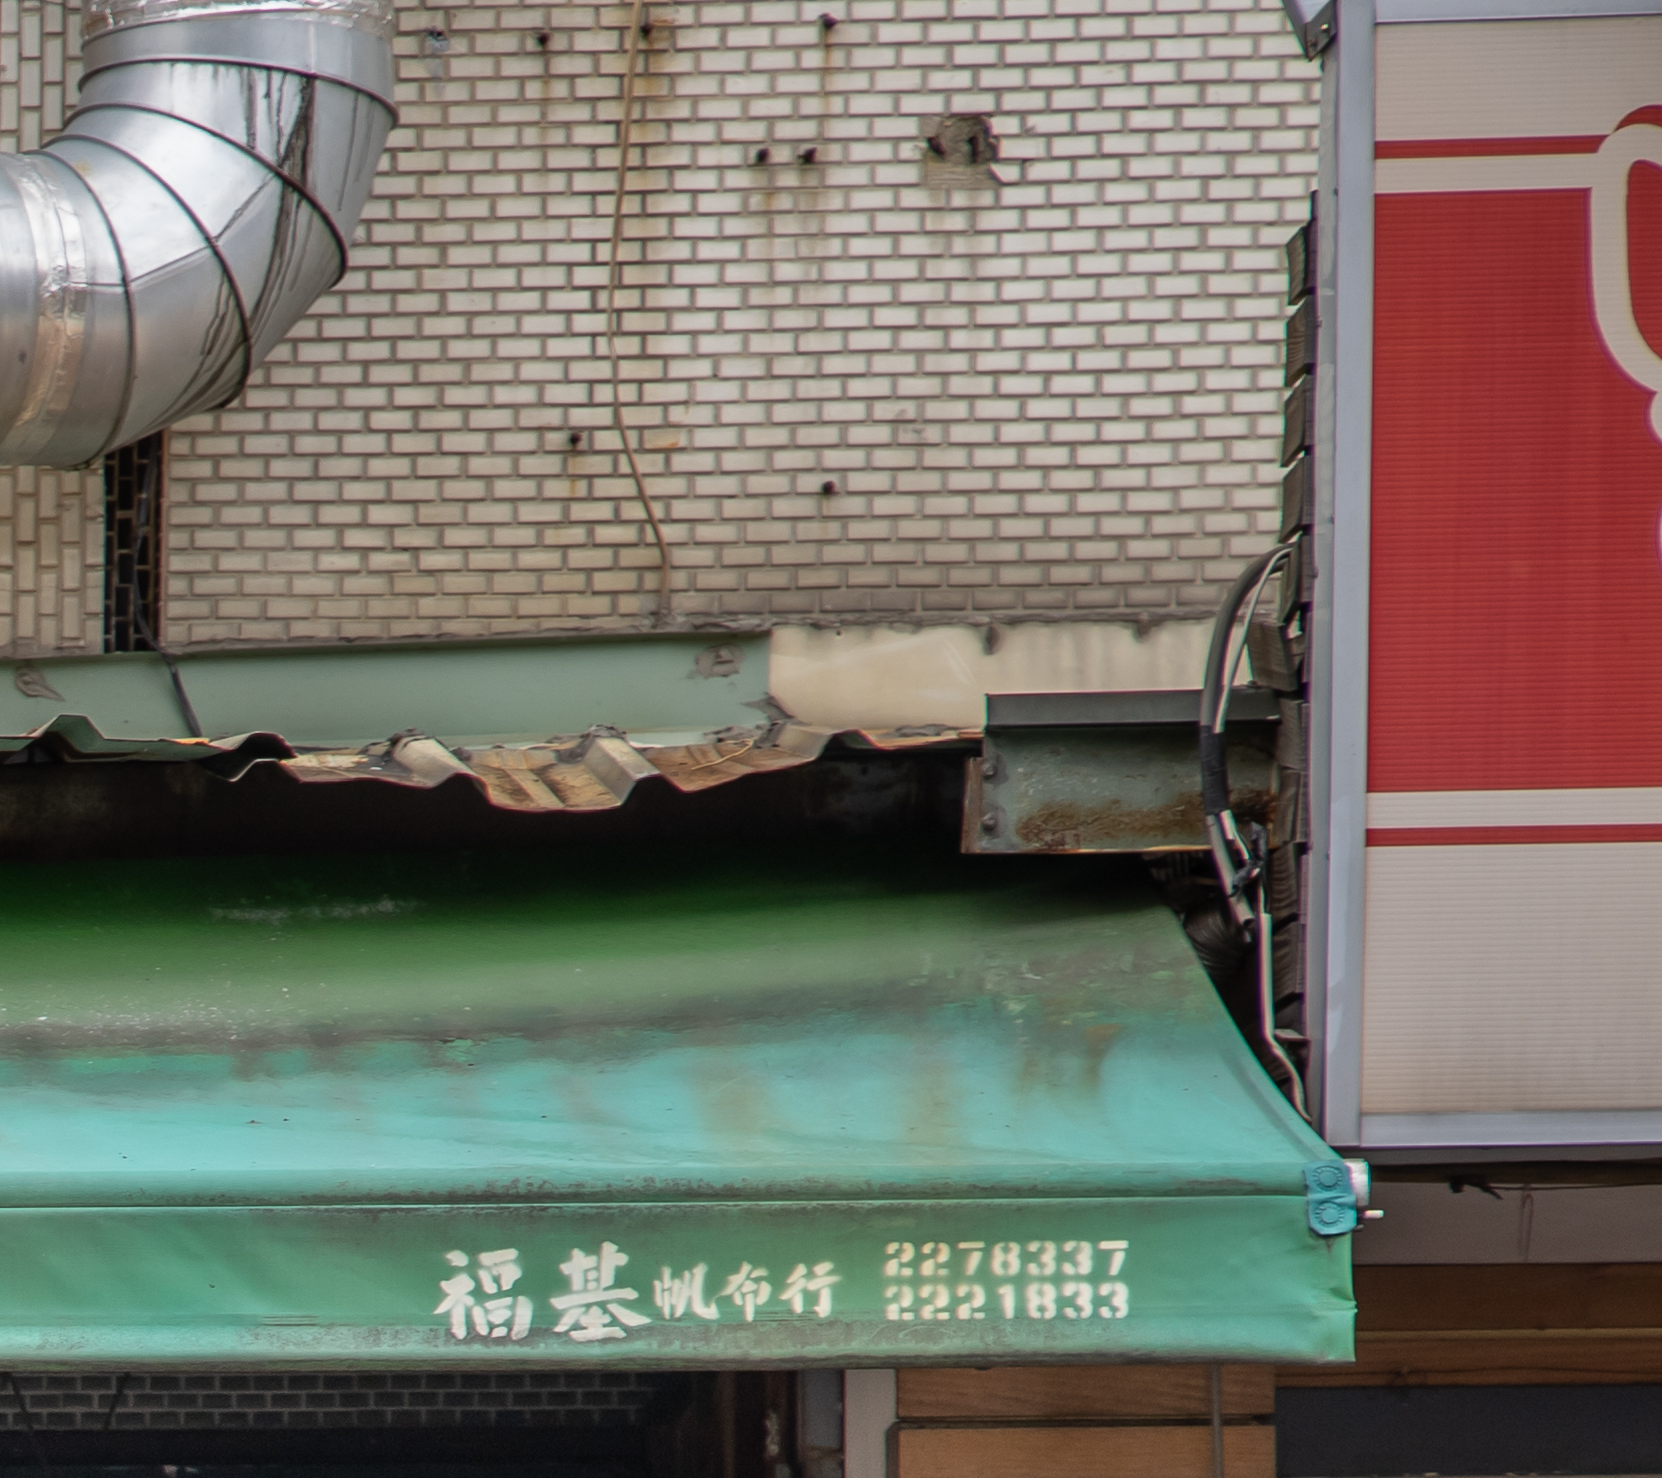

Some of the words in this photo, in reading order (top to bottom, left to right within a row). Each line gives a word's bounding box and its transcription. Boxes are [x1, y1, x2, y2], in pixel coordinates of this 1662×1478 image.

[438, 1241, 841, 1341] 福基帆布行
